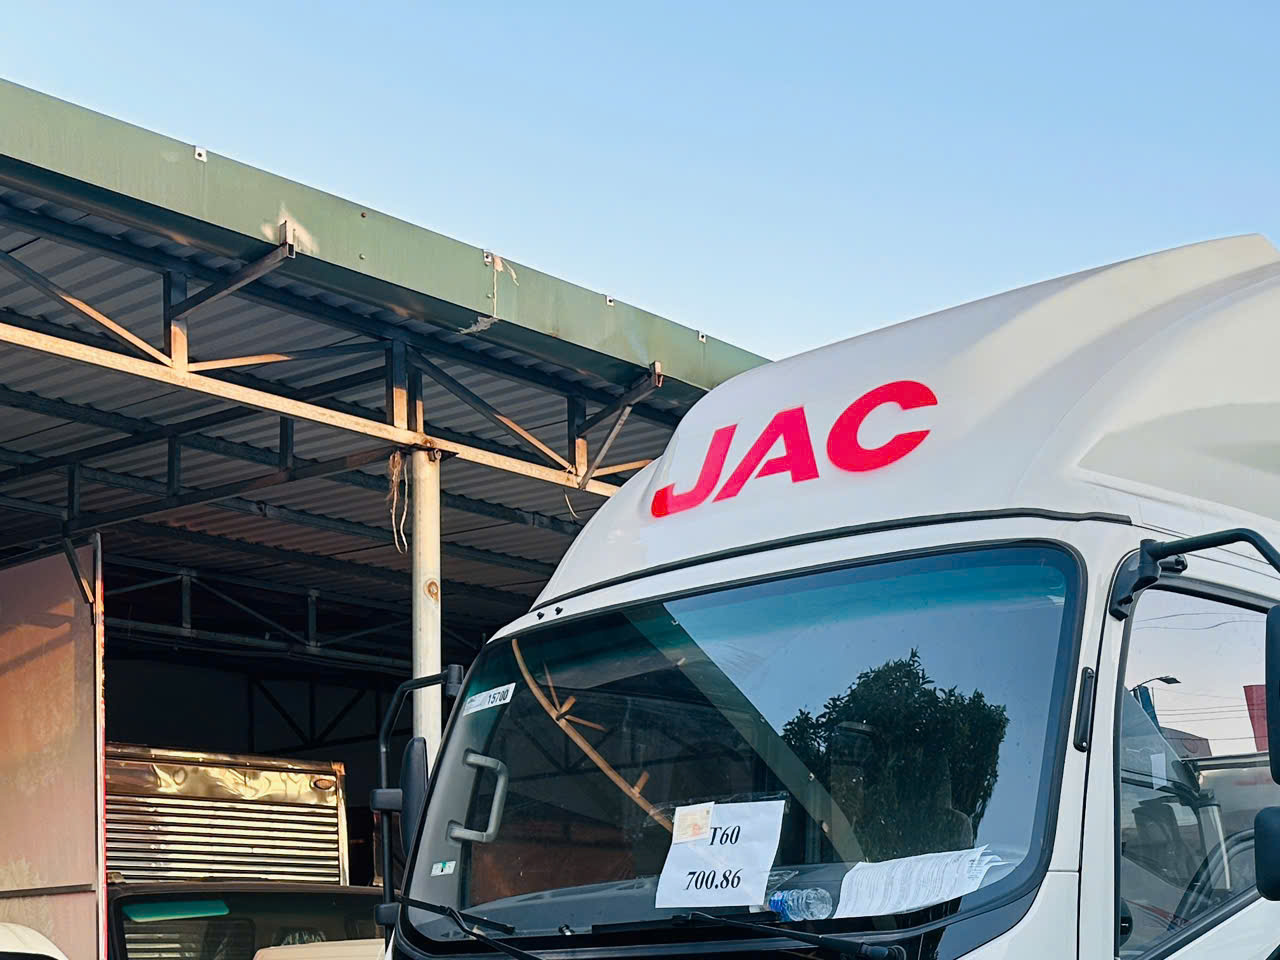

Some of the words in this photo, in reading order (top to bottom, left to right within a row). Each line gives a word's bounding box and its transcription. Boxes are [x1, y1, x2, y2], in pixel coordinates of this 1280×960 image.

[651, 380, 938, 518] JAC
[709, 825, 741, 846] T60
[684, 868, 743, 891] 700.86
